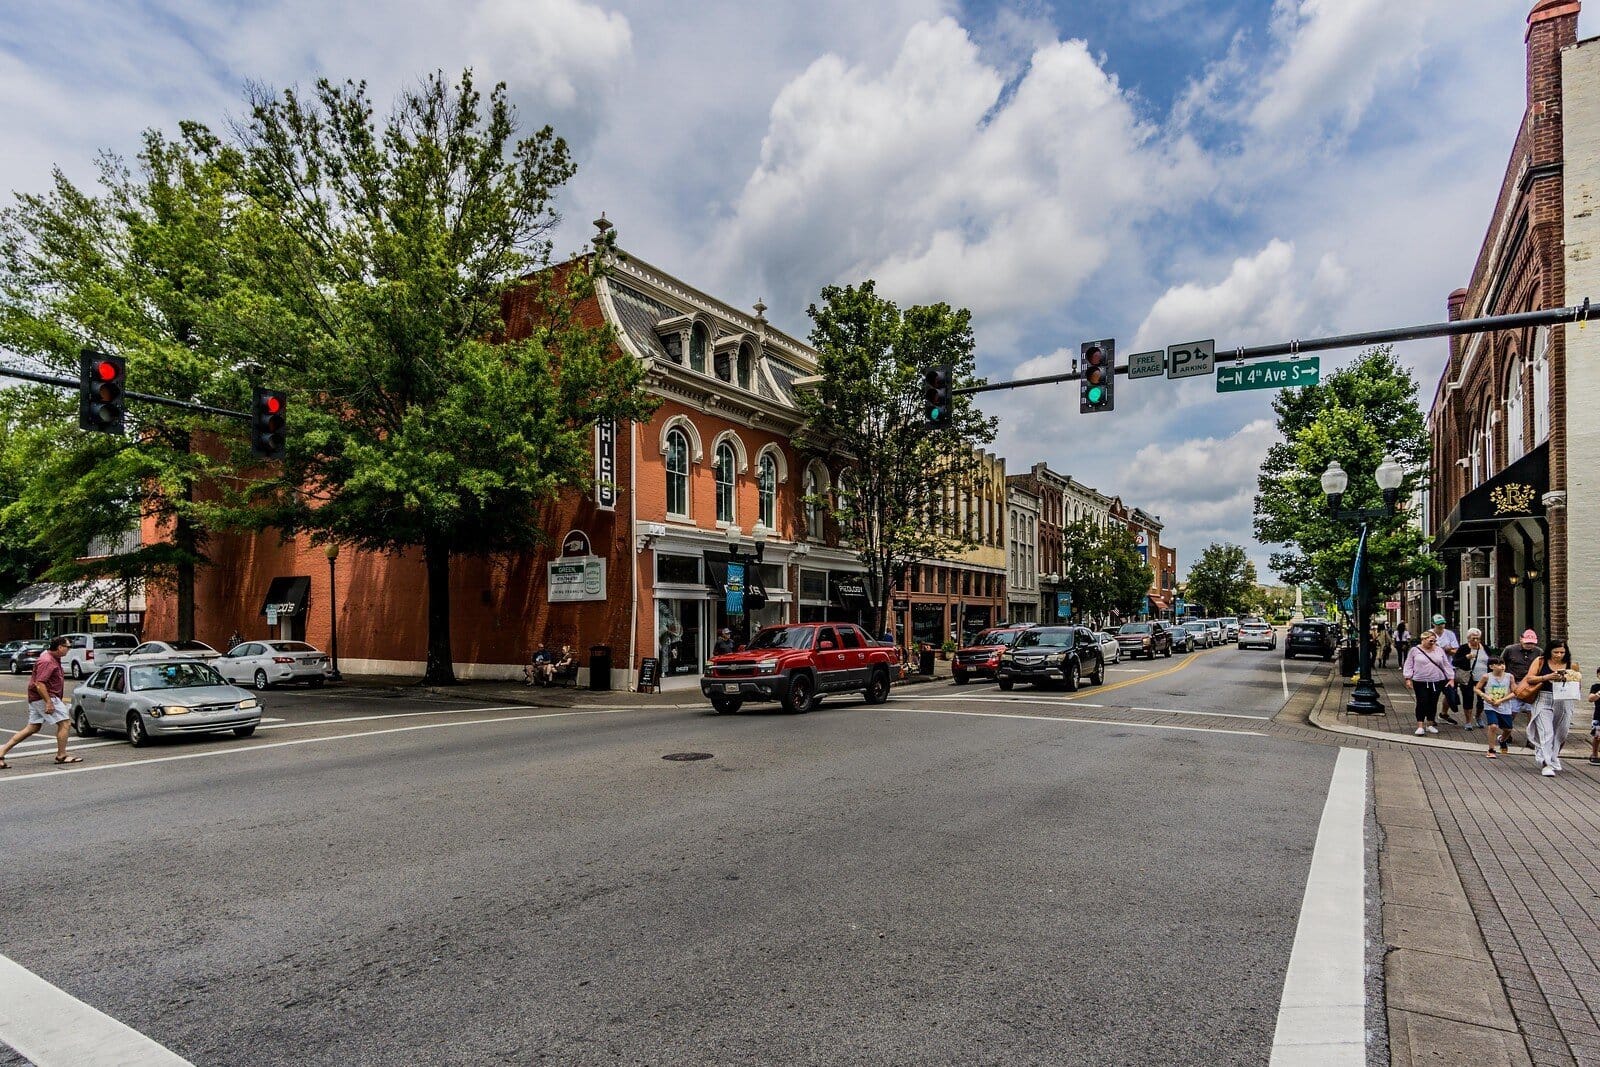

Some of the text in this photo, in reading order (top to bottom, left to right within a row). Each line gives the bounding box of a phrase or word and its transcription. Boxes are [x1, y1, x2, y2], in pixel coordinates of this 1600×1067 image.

[1136, 355, 1156, 365] FREE
[1131, 364, 1161, 375] GARAGE
[1235, 365, 1300, 385] N 4th Ave S
